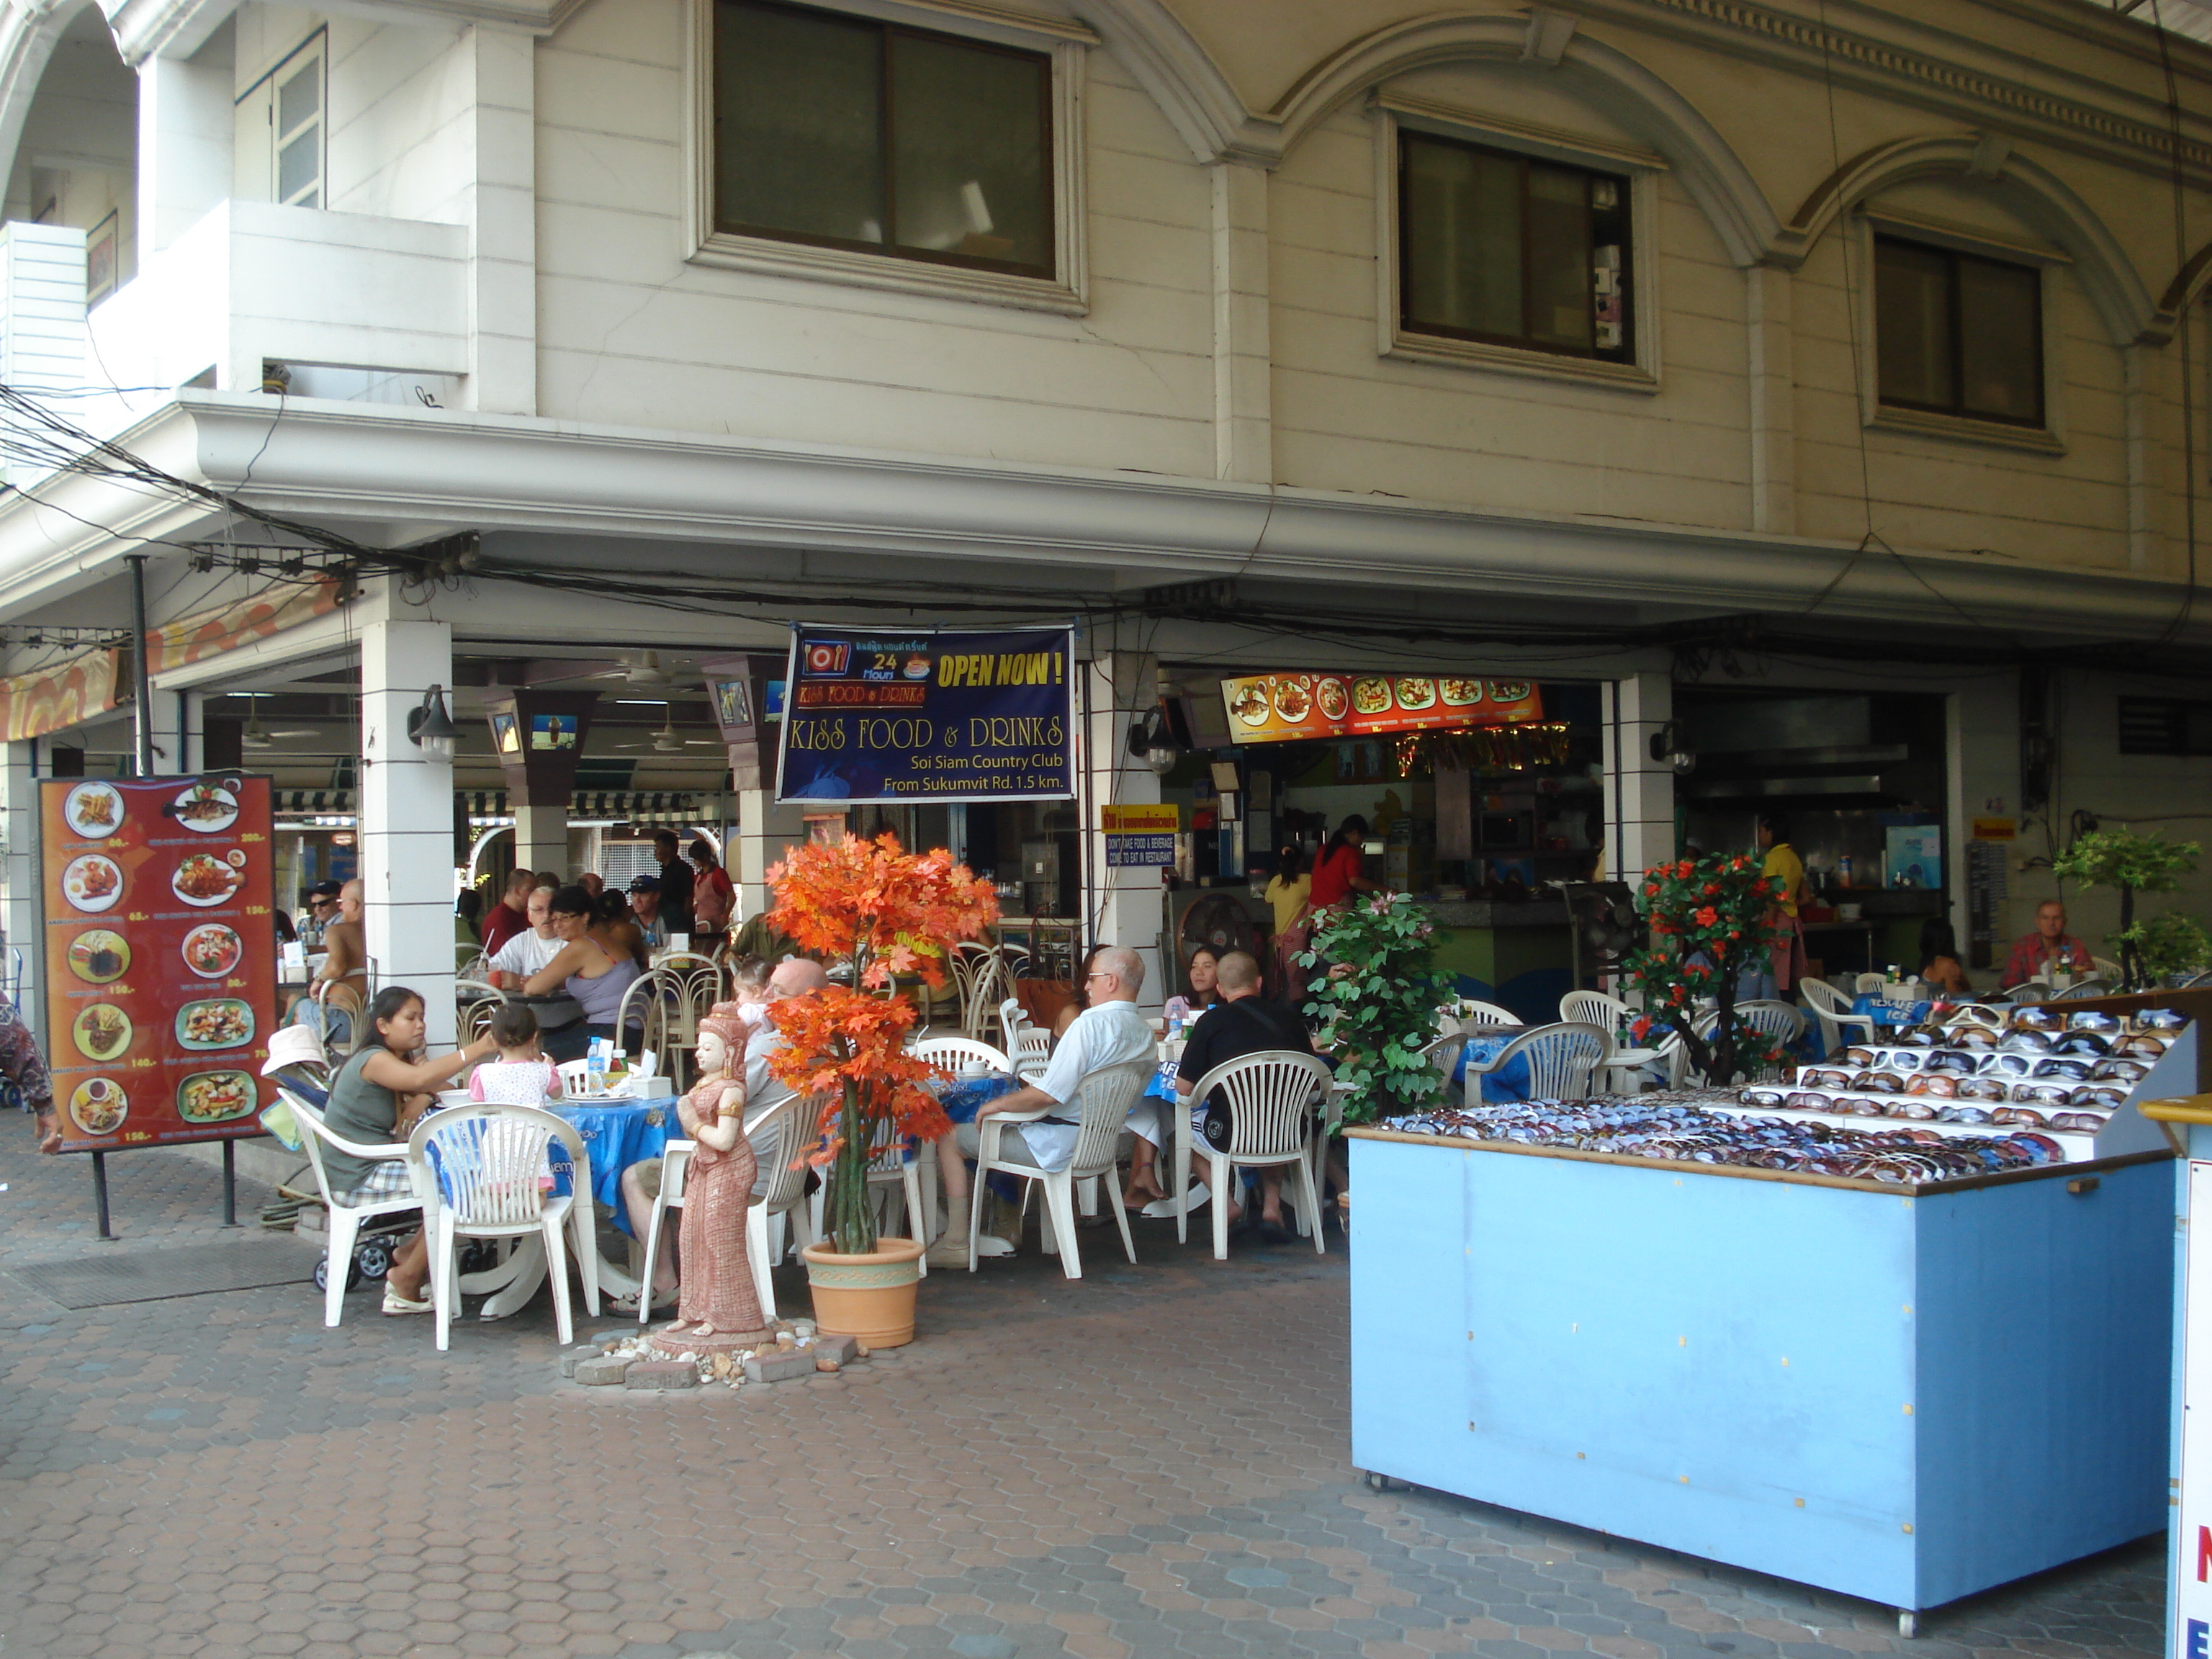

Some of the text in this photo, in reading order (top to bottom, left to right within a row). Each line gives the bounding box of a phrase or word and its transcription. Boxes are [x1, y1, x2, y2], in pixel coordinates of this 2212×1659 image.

[873, 653, 897, 670] 24
[863, 669, 894, 680] Hours
[938, 655, 994, 688] OPEN
[997, 653, 1050, 685] NOW
[799, 686, 925, 703] KISS FOOD & DRINKS
[789, 716, 1064, 750] KISS FOOD & DRINKS
[911, 753, 1064, 771] Soi Siam Country Club
[884, 775, 1064, 791] From Sukumvit Rd. 1.5 km.
[1108, 838, 1120, 850] DON'T
[1134, 837, 1146, 849] FOOD
[1147, 838, 1151, 849] &
[1151, 837, 1173, 849] BEVERAGE
[1123, 852, 1129, 863] TO
[1130, 852, 1138, 863] EAT
[1139, 852, 1144, 863] IN
[1145, 851, 1172, 863] RESTAURANT
